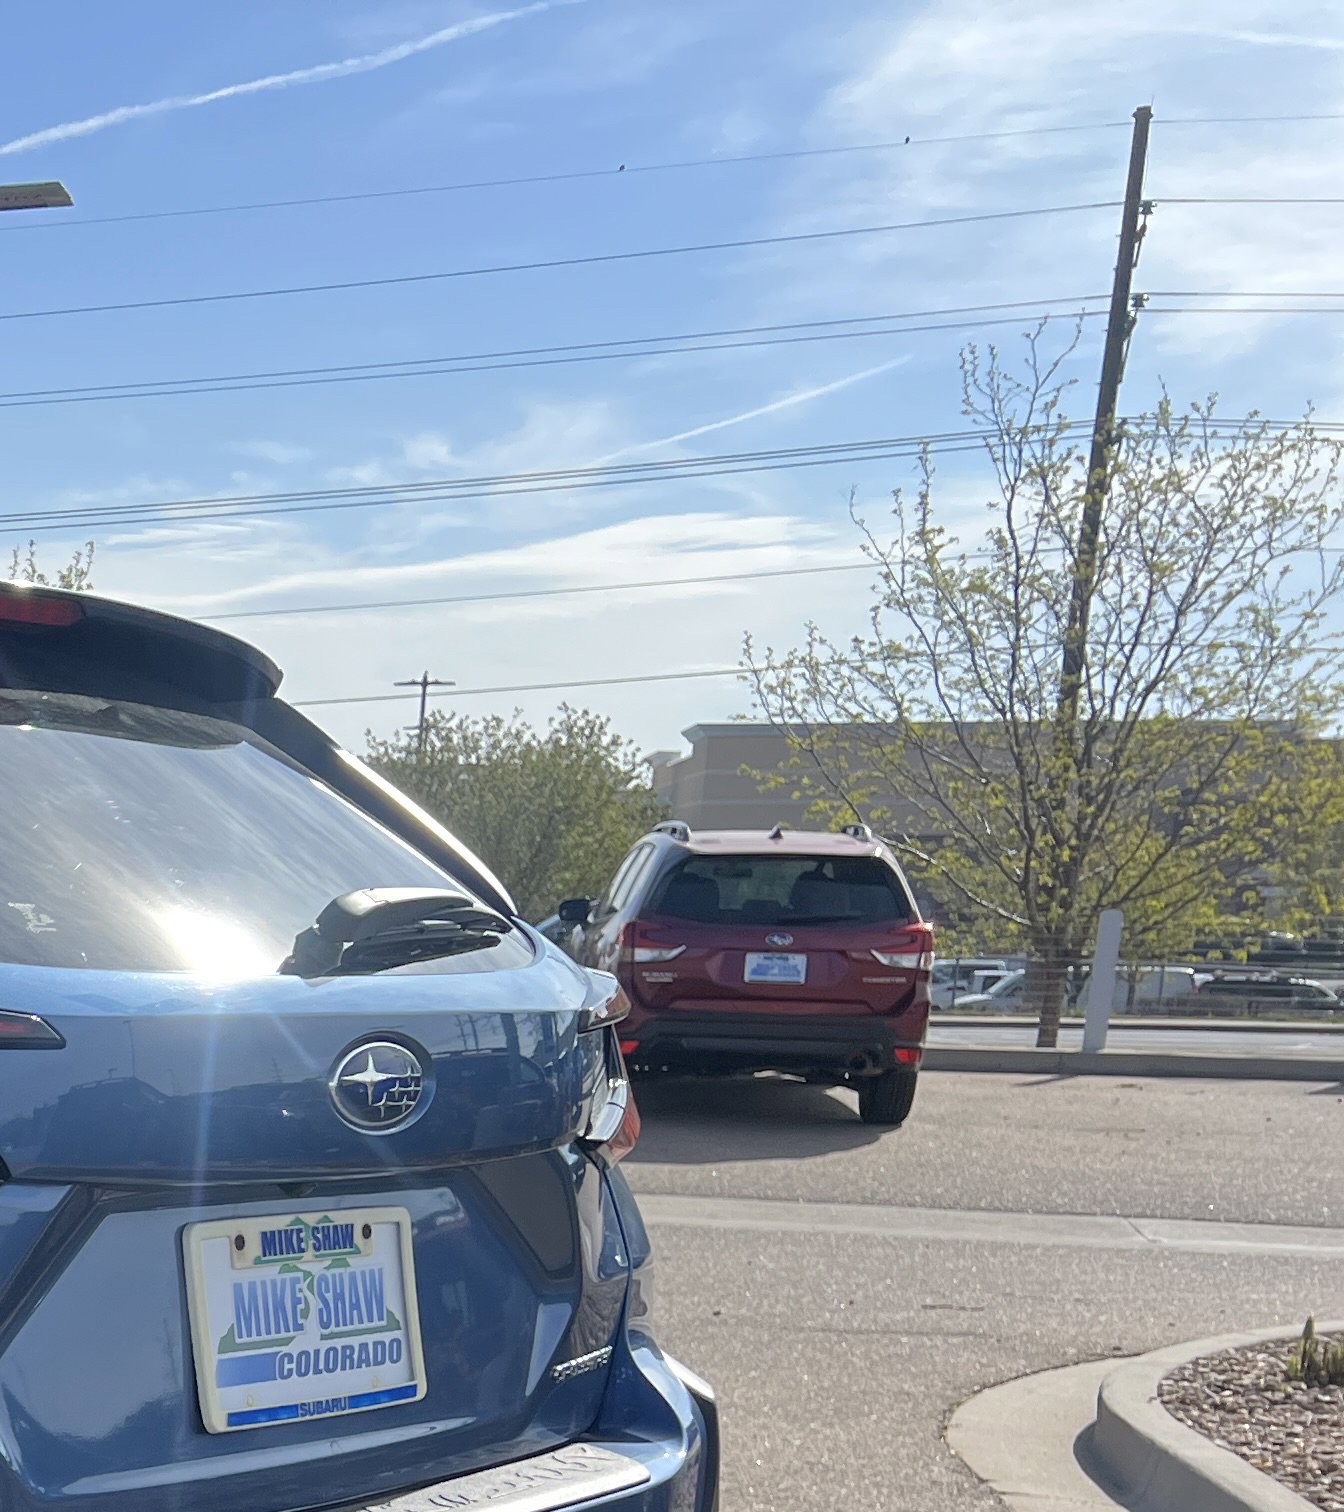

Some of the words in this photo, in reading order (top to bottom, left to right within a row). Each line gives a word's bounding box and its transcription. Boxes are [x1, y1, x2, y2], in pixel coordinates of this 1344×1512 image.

[261, 1229, 305, 1257] MIKE
[312, 1224, 354, 1252] SHAW
[233, 1277, 304, 1339] MIKE
[315, 1267, 385, 1330] SHAW
[277, 1338, 402, 1380] COLORADO
[298, 1397, 348, 1417] SUBARU
